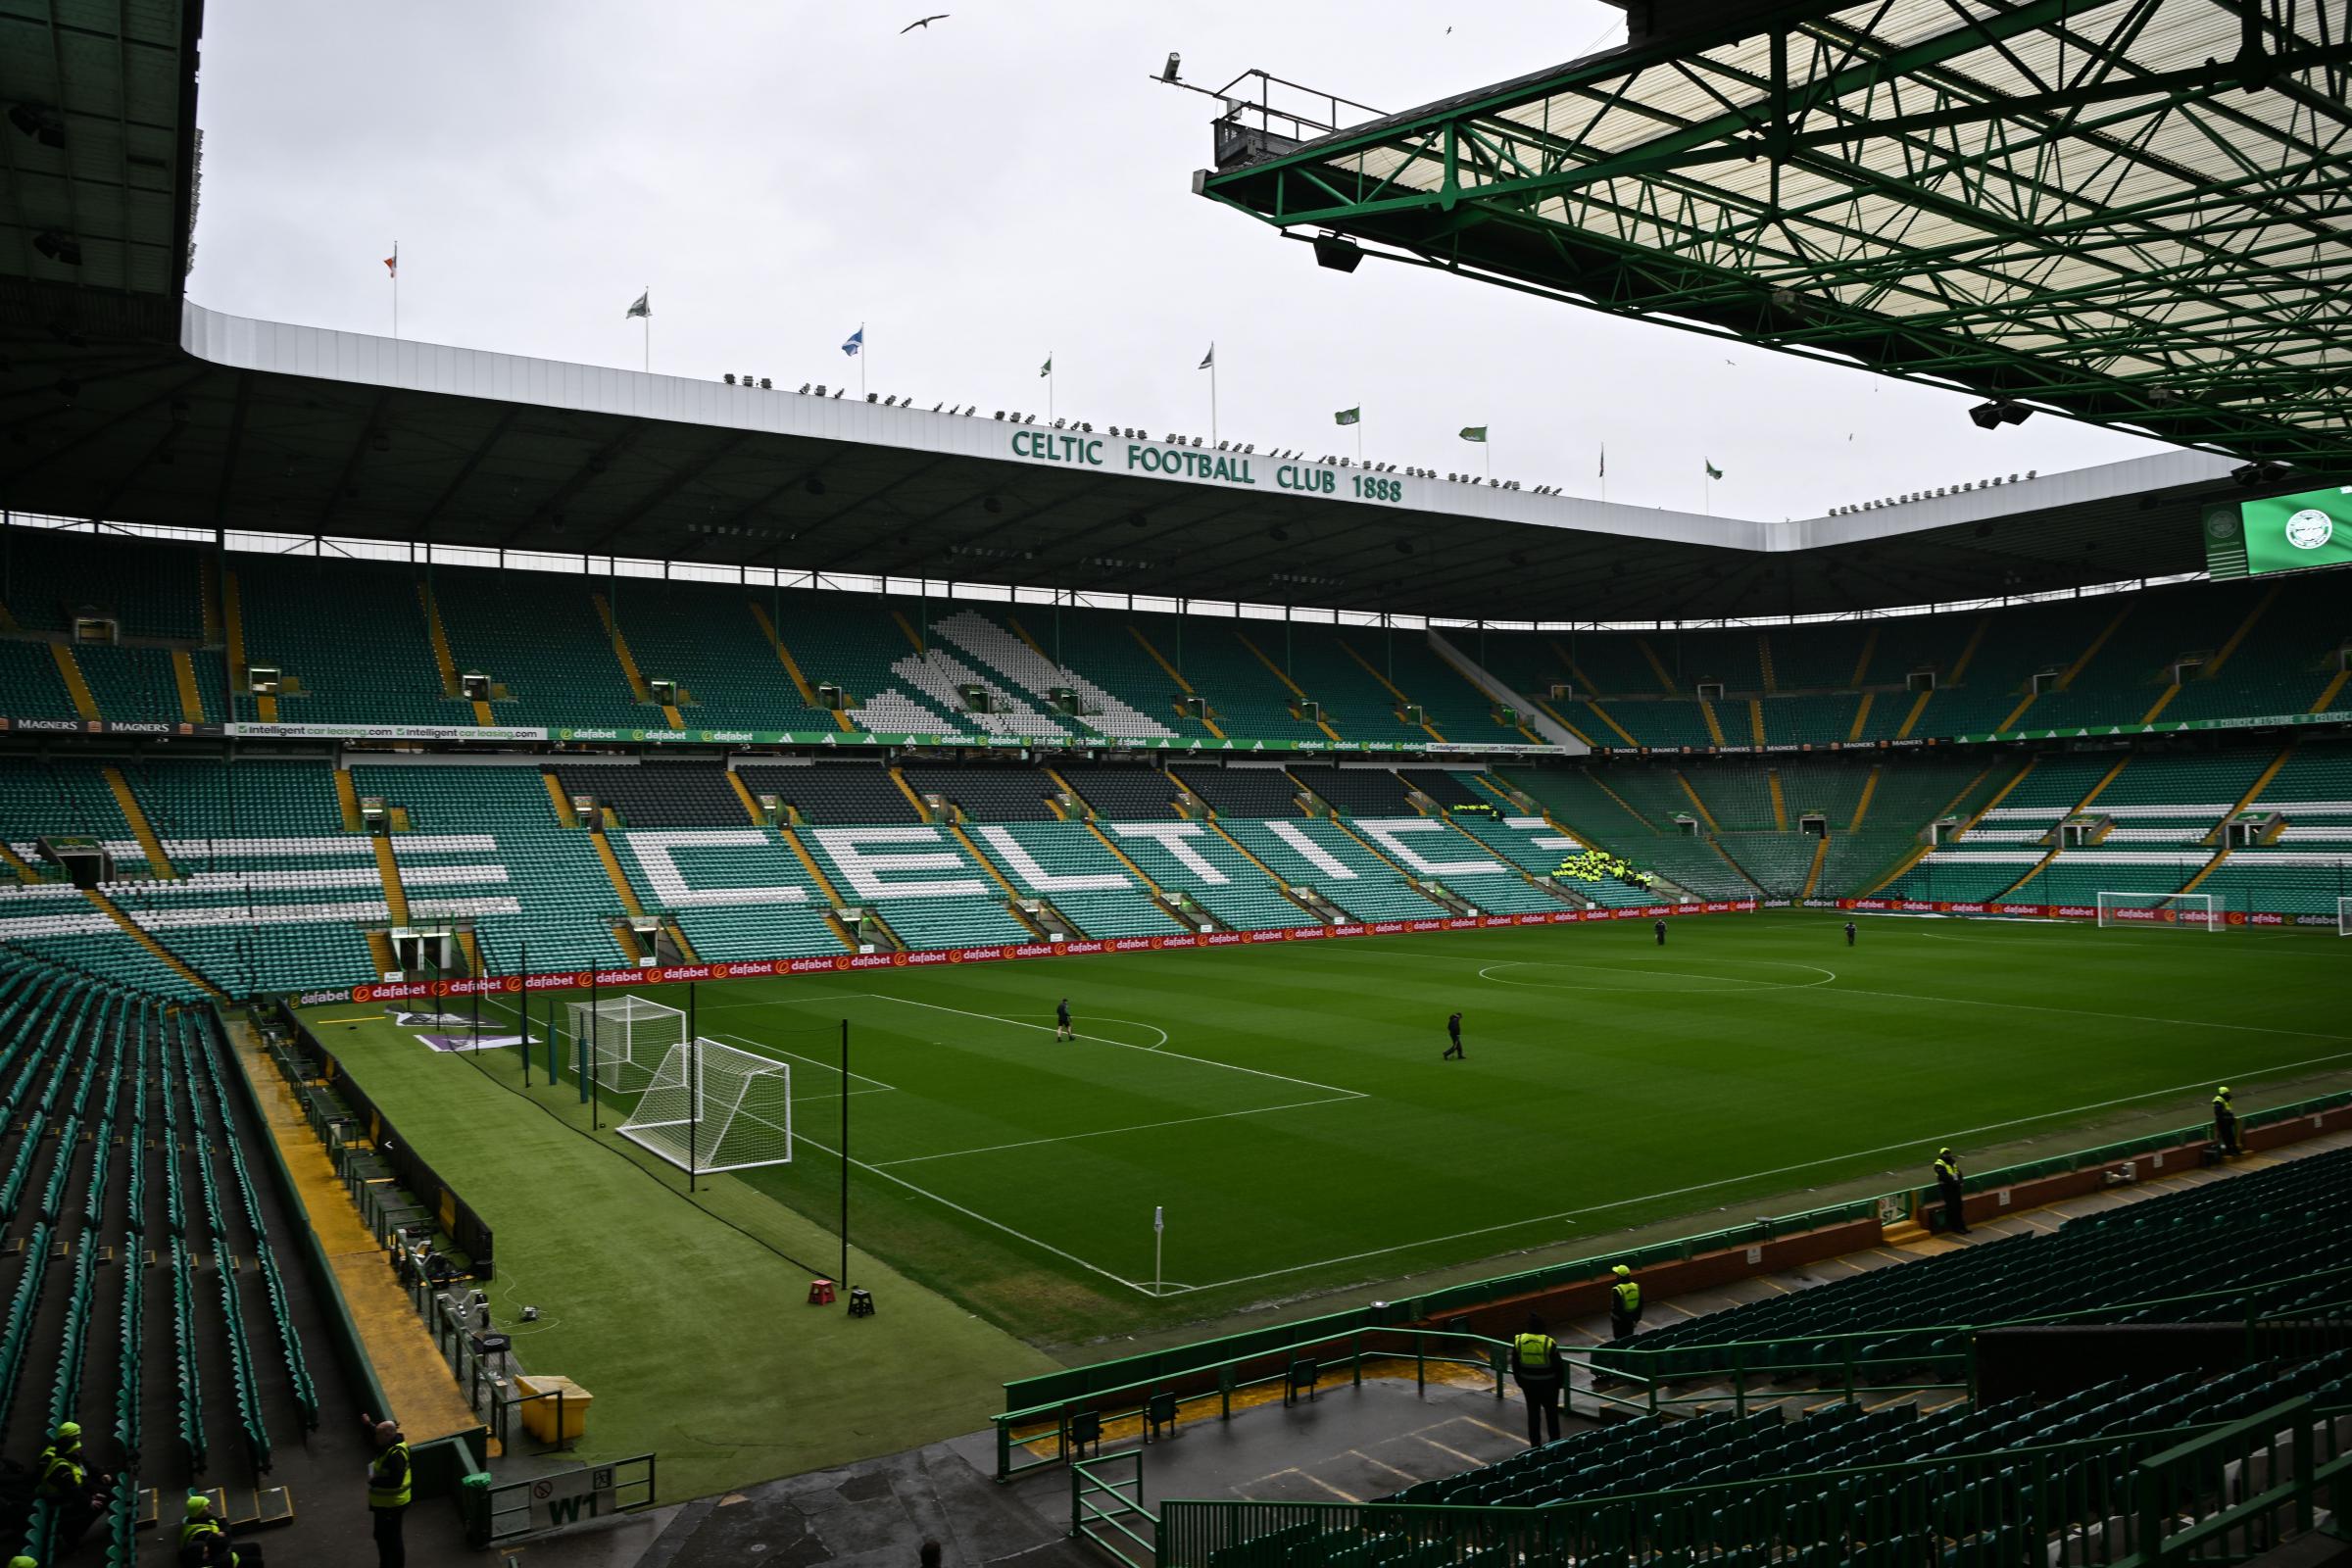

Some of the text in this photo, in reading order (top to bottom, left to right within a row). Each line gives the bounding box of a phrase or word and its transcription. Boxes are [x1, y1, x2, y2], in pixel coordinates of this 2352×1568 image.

[1012, 430, 1401, 503] CELTIC FOOTBALL CLUB 1888
[18, 719, 78, 731] MAGNERS
[111, 722, 170, 733] MAGNERS
[249, 725, 305, 737] Intelligent
[406, 728, 457, 739] Intelligent
[573, 728, 616, 741] dafabet
[646, 729, 686, 742] dafabet
[712, 730, 753, 743] dafabet
[941, 735, 975, 746] dafabet
[987, 736, 1020, 747] dafabet
[624, 817, 1507, 907] CELTIC
[2003, 904, 2037, 915] dafabet
[2058, 906, 2093, 917] dafabet
[2117, 909, 2154, 919] dafabet
[1336, 925, 1363, 937] dafabet
[1376, 923, 1402, 934] dafabet
[1413, 920, 1439, 931] dafabet
[1209, 933, 1239, 945] dafabet
[1253, 930, 1282, 942] dafabet
[1296, 928, 1323, 939] dafabet
[1117, 938, 1149, 951] dafabet
[1163, 936, 1195, 948] dafabet
[1016, 945, 1052, 957] dafabet
[1067, 942, 1101, 955] dafabet
[908, 952, 946, 964] dafabet
[963, 949, 1001, 961] dafabet
[791, 958, 832, 972] dafabet
[851, 955, 890, 968] dafabet
[664, 966, 709, 980] dafabet
[729, 962, 772, 976] dafabet
[525, 975, 573, 990] dafabet
[596, 971, 643, 984] dafabet
[301, 990, 350, 1005] dafabet
[372, 984, 425, 999] dafabet
[549, 1492, 598, 1526] W1
